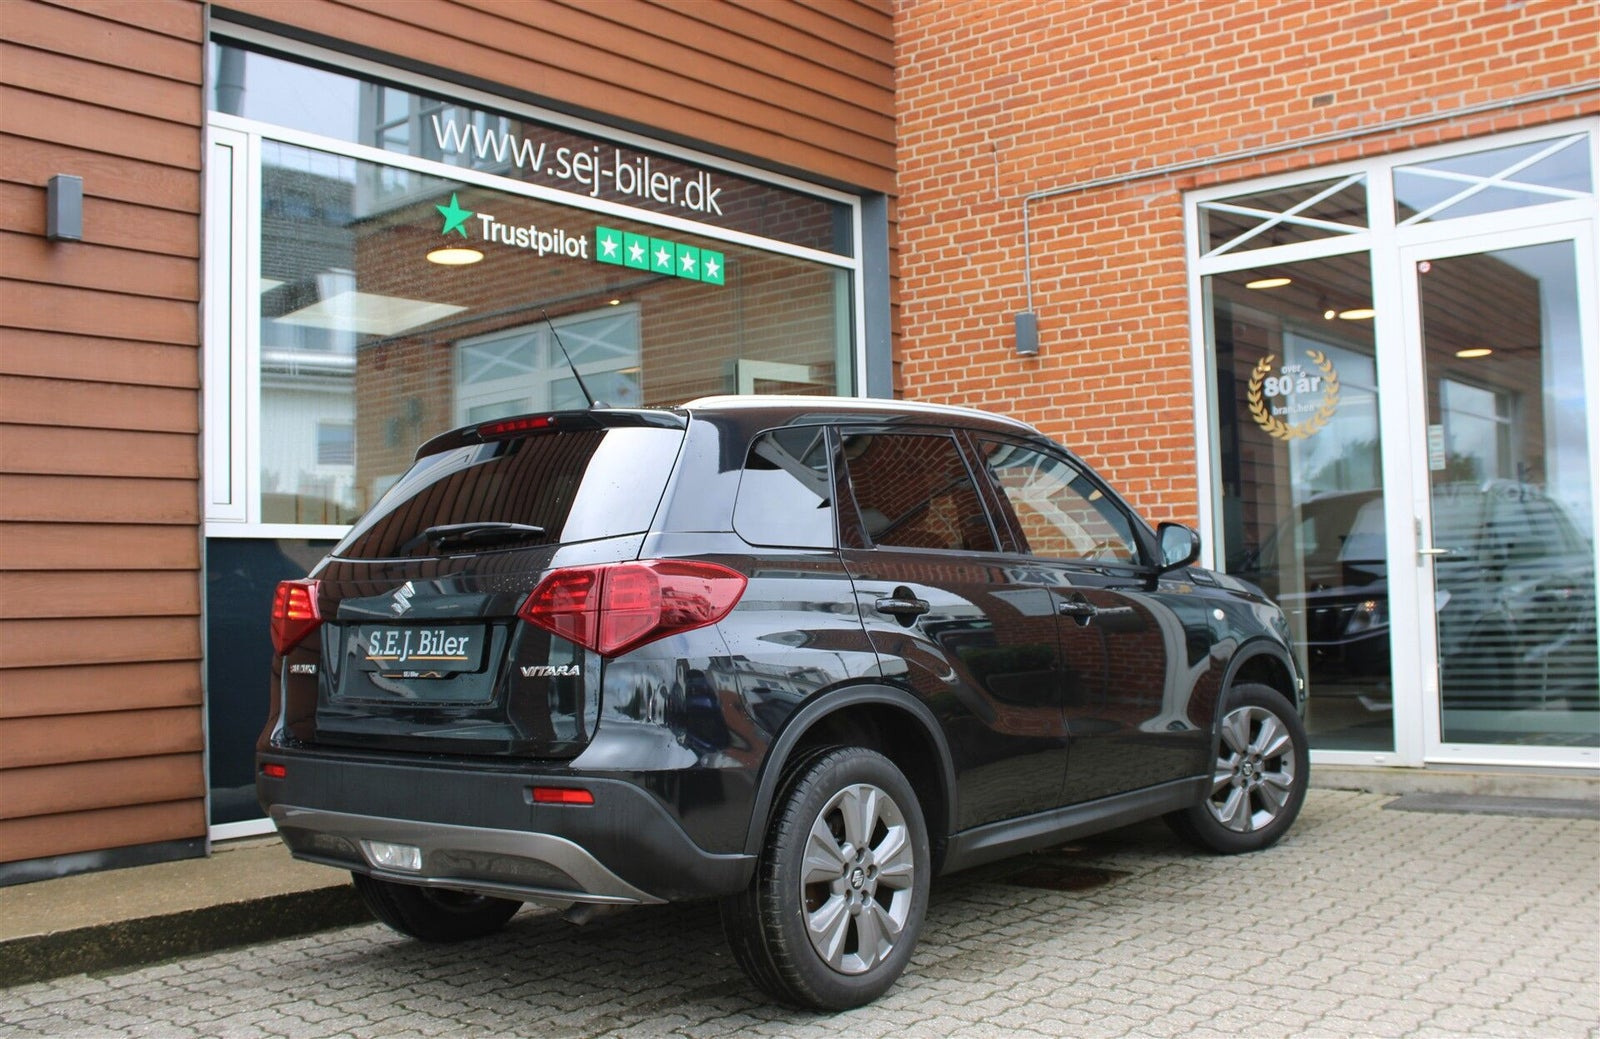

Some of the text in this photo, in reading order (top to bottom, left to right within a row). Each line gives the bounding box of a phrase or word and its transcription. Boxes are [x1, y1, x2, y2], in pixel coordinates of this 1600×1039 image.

[432, 115, 723, 216] www.sej-biler.dk
[477, 213, 588, 259] Trustpilot
[1281, 364, 1302, 374] over
[1264, 371, 1320, 397] 80 år
[368, 630, 469, 662] S.E.J. Biler
[520, 665, 580, 677] VITARA
